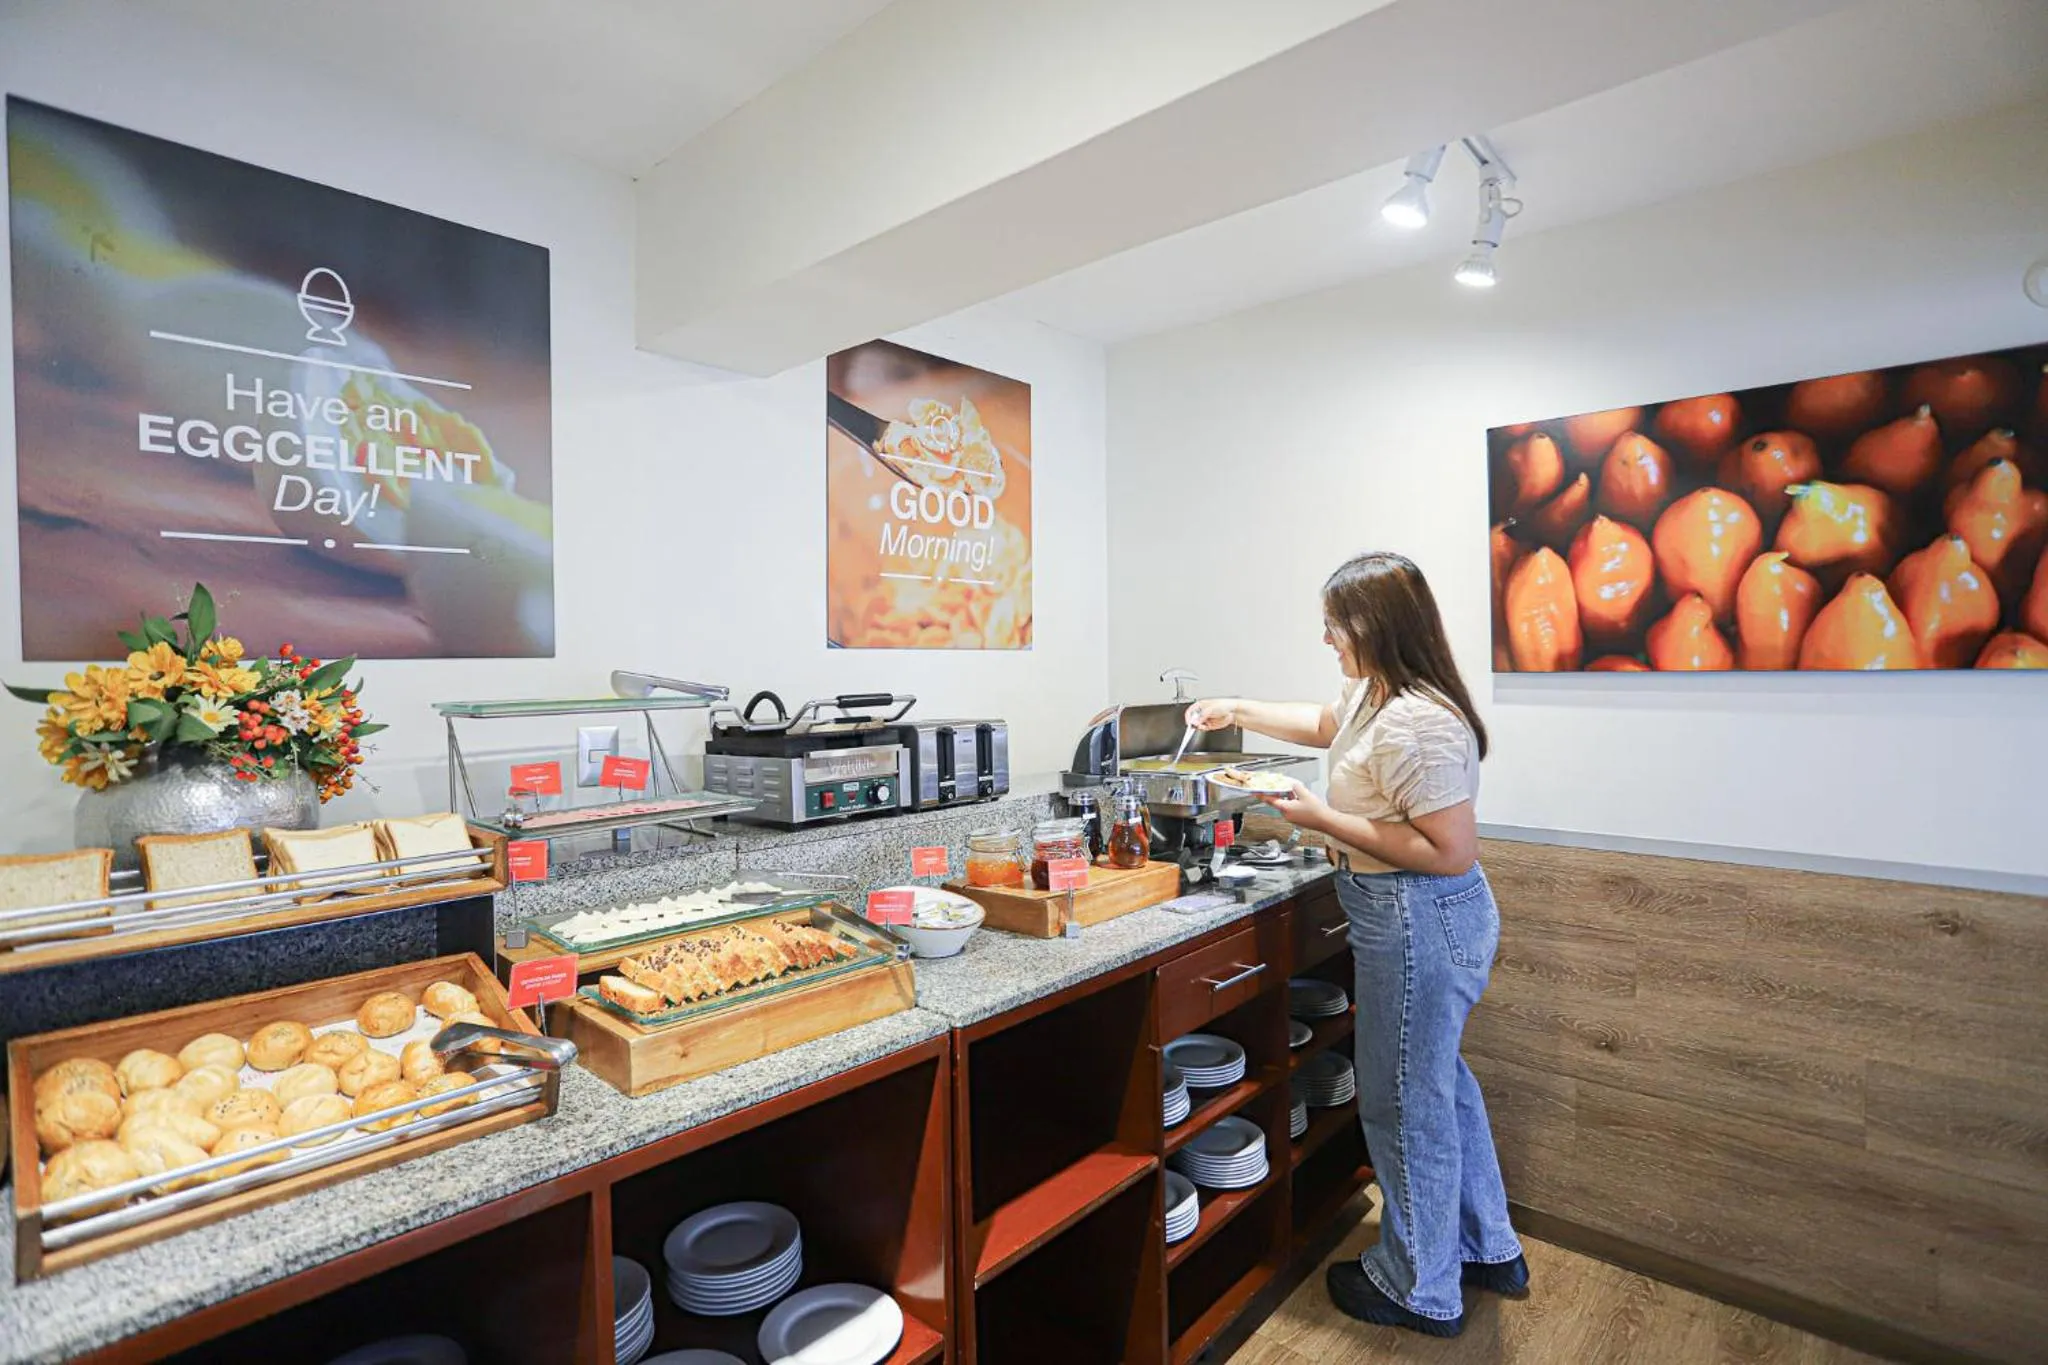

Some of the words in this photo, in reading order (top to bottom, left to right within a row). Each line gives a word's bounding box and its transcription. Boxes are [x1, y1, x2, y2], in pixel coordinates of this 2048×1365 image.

[226, 373, 349, 425] Have
[366, 403, 418, 435] an
[138, 413, 481, 485] EGGCELLENT
[273, 474, 381, 526] Day!
[890, 480, 995, 530] GOOD
[880, 522, 994, 572] Morning!
